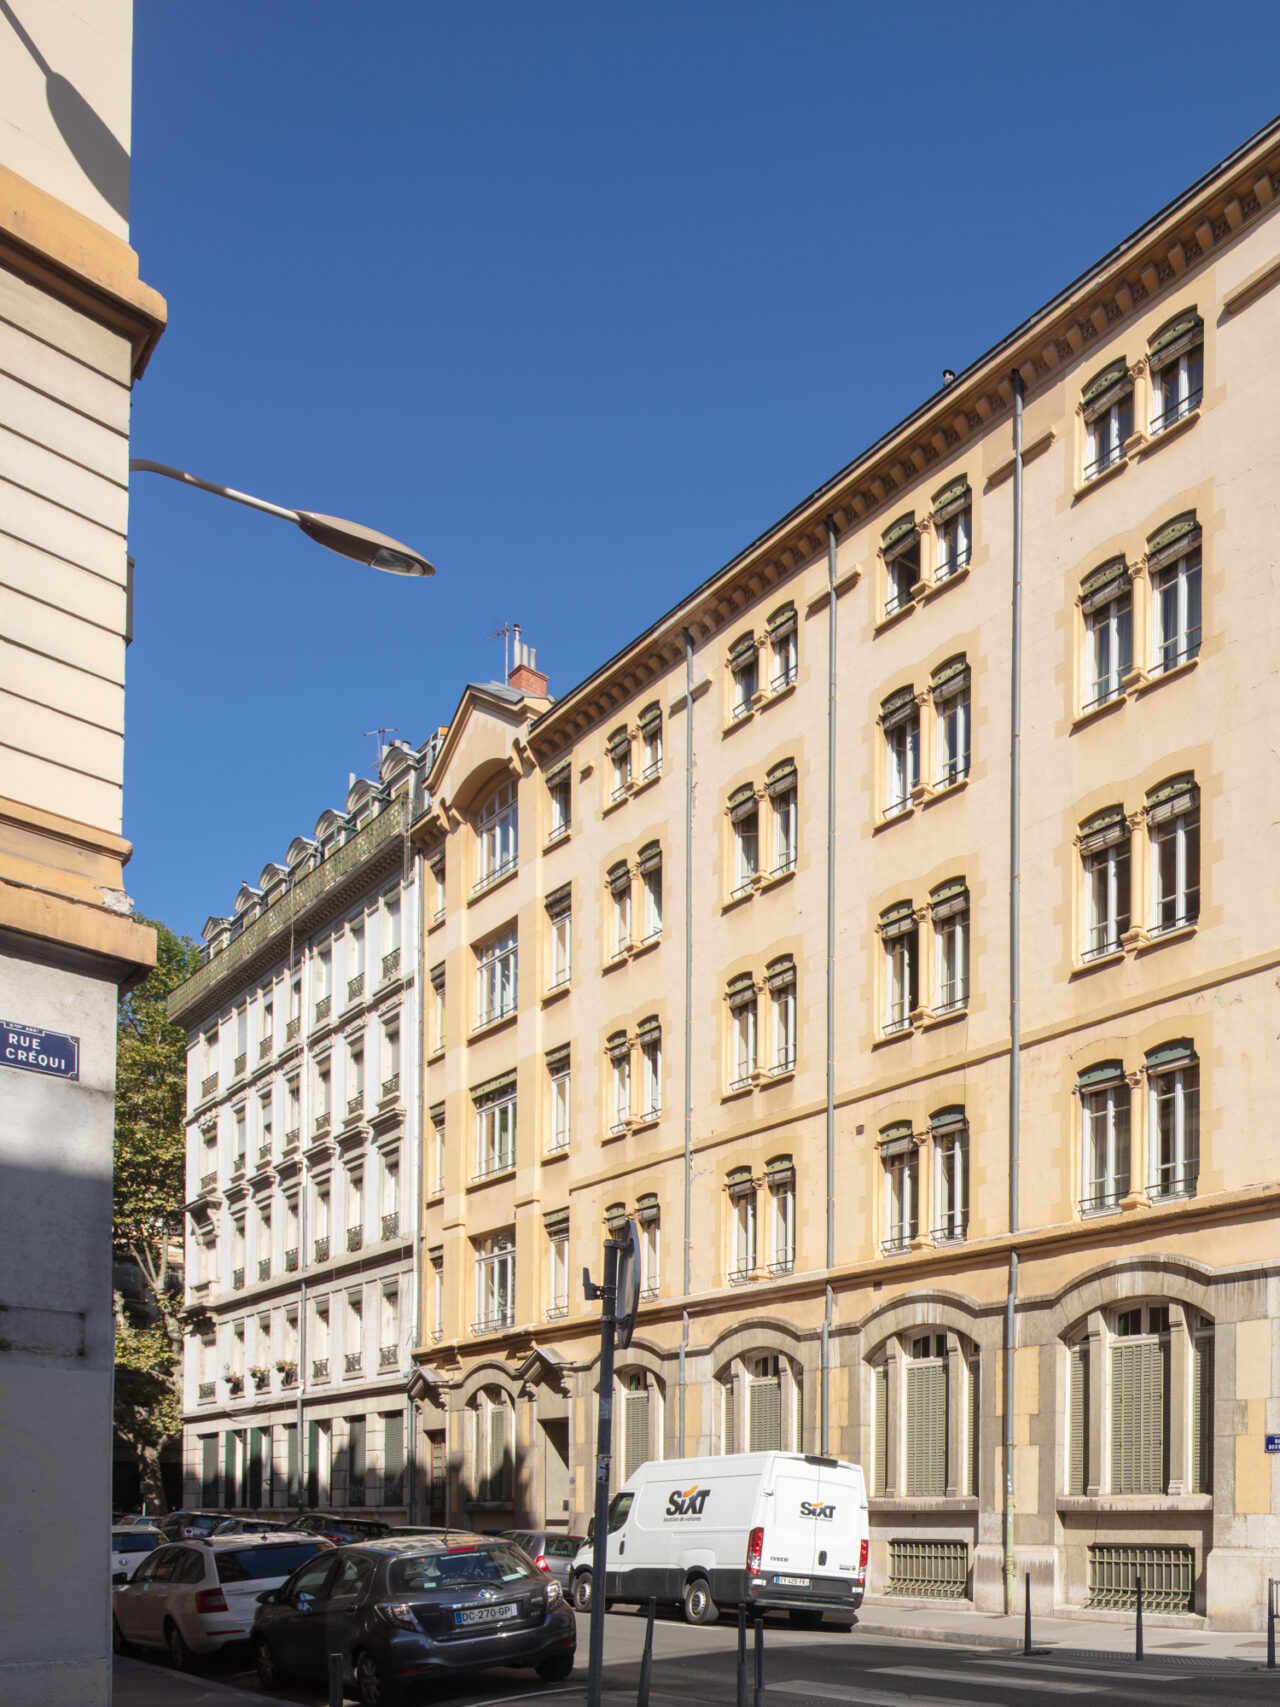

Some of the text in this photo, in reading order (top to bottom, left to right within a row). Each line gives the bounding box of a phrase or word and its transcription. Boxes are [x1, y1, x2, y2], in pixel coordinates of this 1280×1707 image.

[9, 1033, 40, 1050] RUE
[5, 1047, 65, 1070] CRÉQUI
[666, 1485, 711, 1516] SIXT
[800, 1501, 836, 1519] SIXT
[462, 1606, 511, 1621] DC-270-GP
